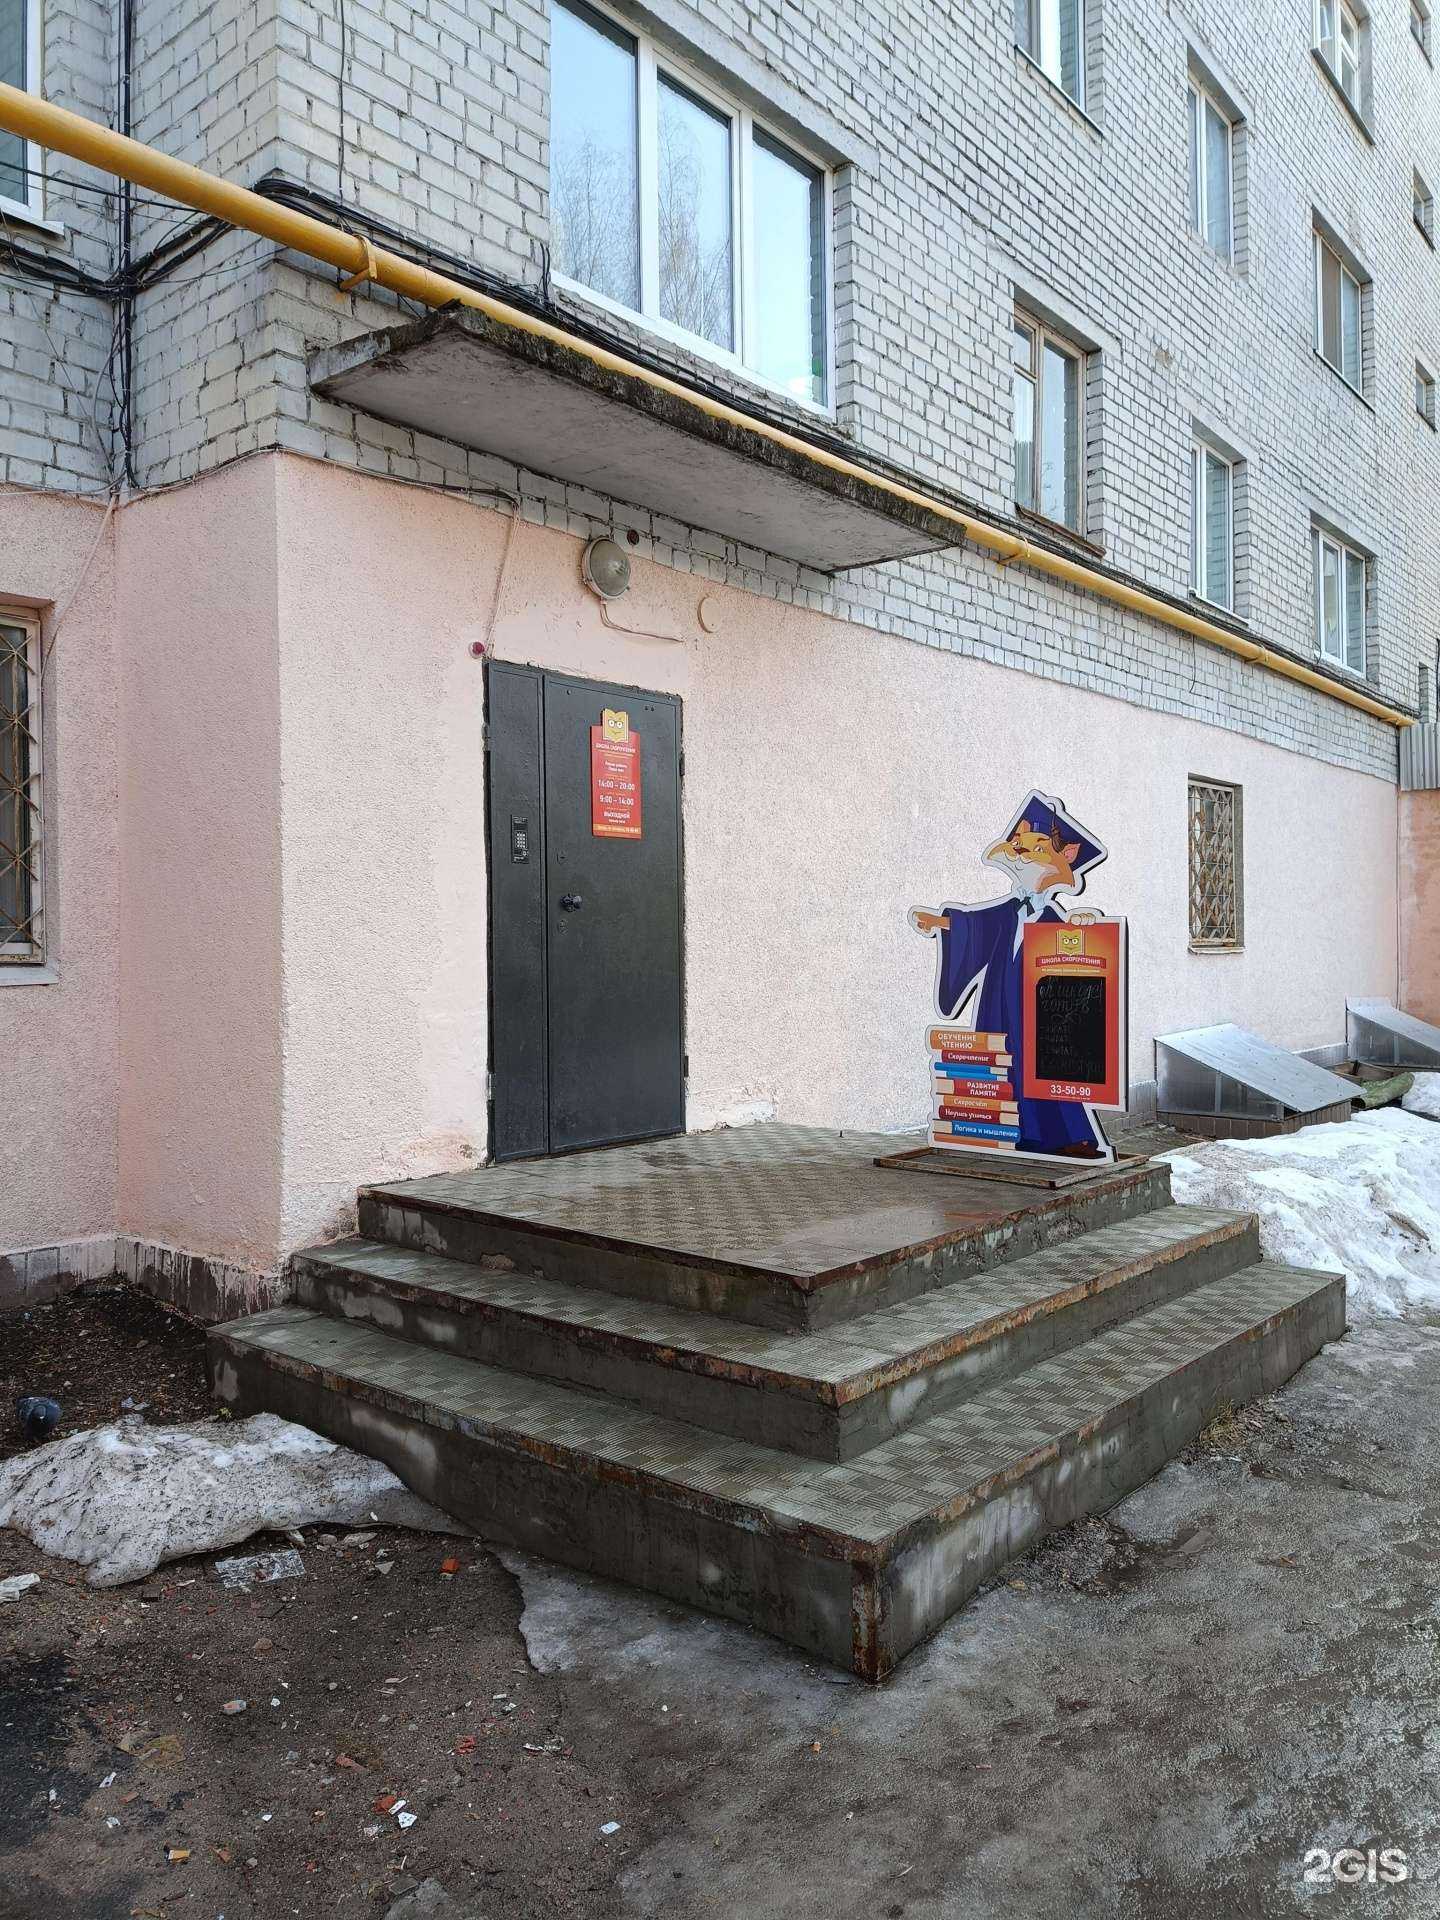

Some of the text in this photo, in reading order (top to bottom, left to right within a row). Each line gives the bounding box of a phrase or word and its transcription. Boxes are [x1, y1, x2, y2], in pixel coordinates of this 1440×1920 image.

[598, 779, 614, 789] 14:00
[619, 782, 636, 791] 20:00
[618, 796, 635, 806] 14:00
[1041, 956, 1101, 965] ШКОЛА СКОРОЧТЕНИЯ
[937, 1033, 977, 1042] ОБУЧЕНИЕ
[941, 1041, 973, 1049] ЧТЕНИЮ
[947, 1052, 990, 1062] Скорочтение
[966, 1081, 1000, 1091] РАЗВИТИЕ
[1050, 1084, 1091, 1097] 33-50-90
[969, 1089, 997, 1097] ПАМЯТИ
[954, 1124, 977, 1134] Логика
[983, 1128, 1019, 1139] мышление
